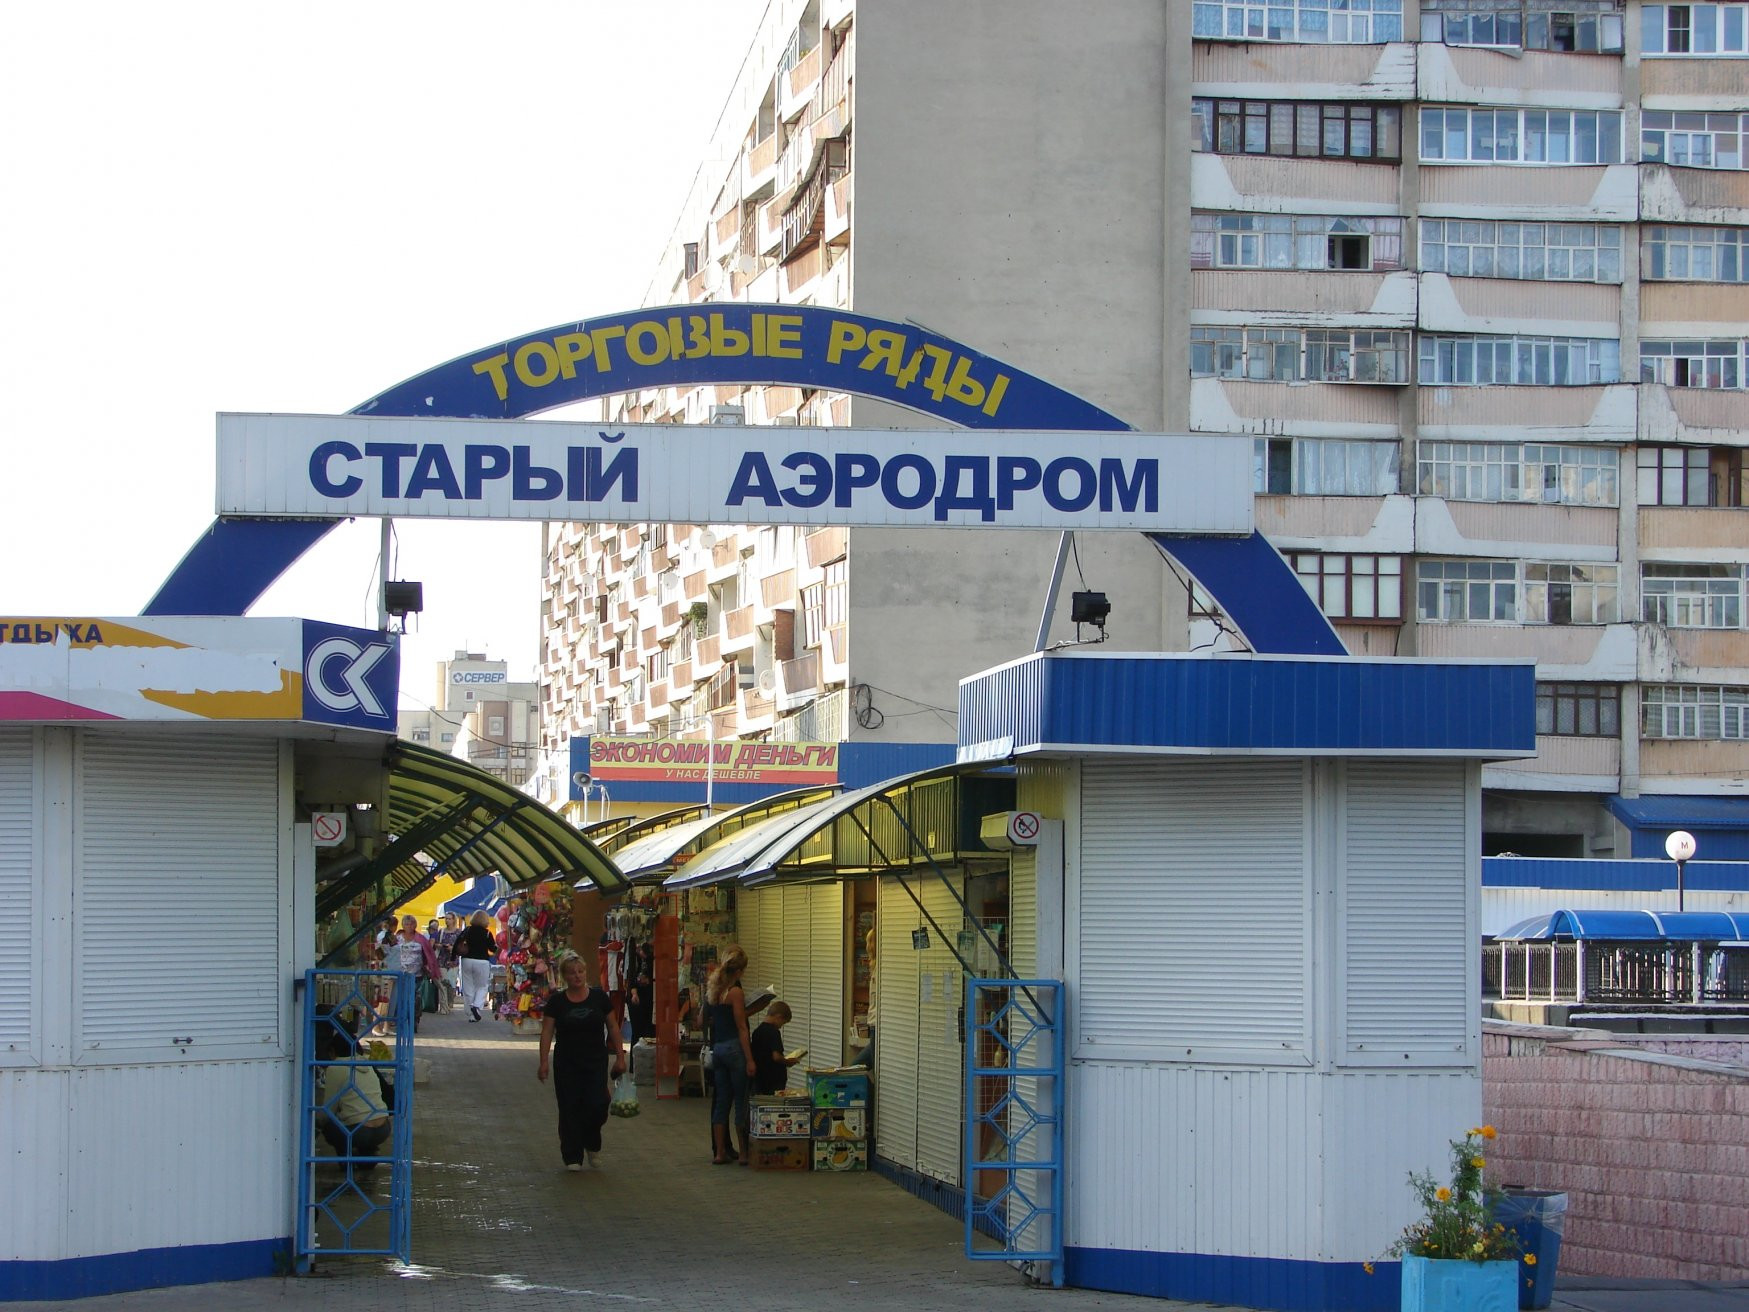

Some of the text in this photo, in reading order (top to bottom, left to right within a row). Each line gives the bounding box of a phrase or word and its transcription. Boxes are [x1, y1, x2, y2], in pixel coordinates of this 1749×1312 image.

[473, 313, 1010, 417] ТОРГОВЫЕ РЯДЫ
[308, 432, 1159, 522] СТАРЫЙ АЭРОДРОМ
[464, 672, 505, 683] СЕРВЕР
[590, 741, 837, 769] ЭКОНОМИМ ДЕНЬГИ
[666, 769, 761, 780] У НАС ДЕШЕВЛЕ
